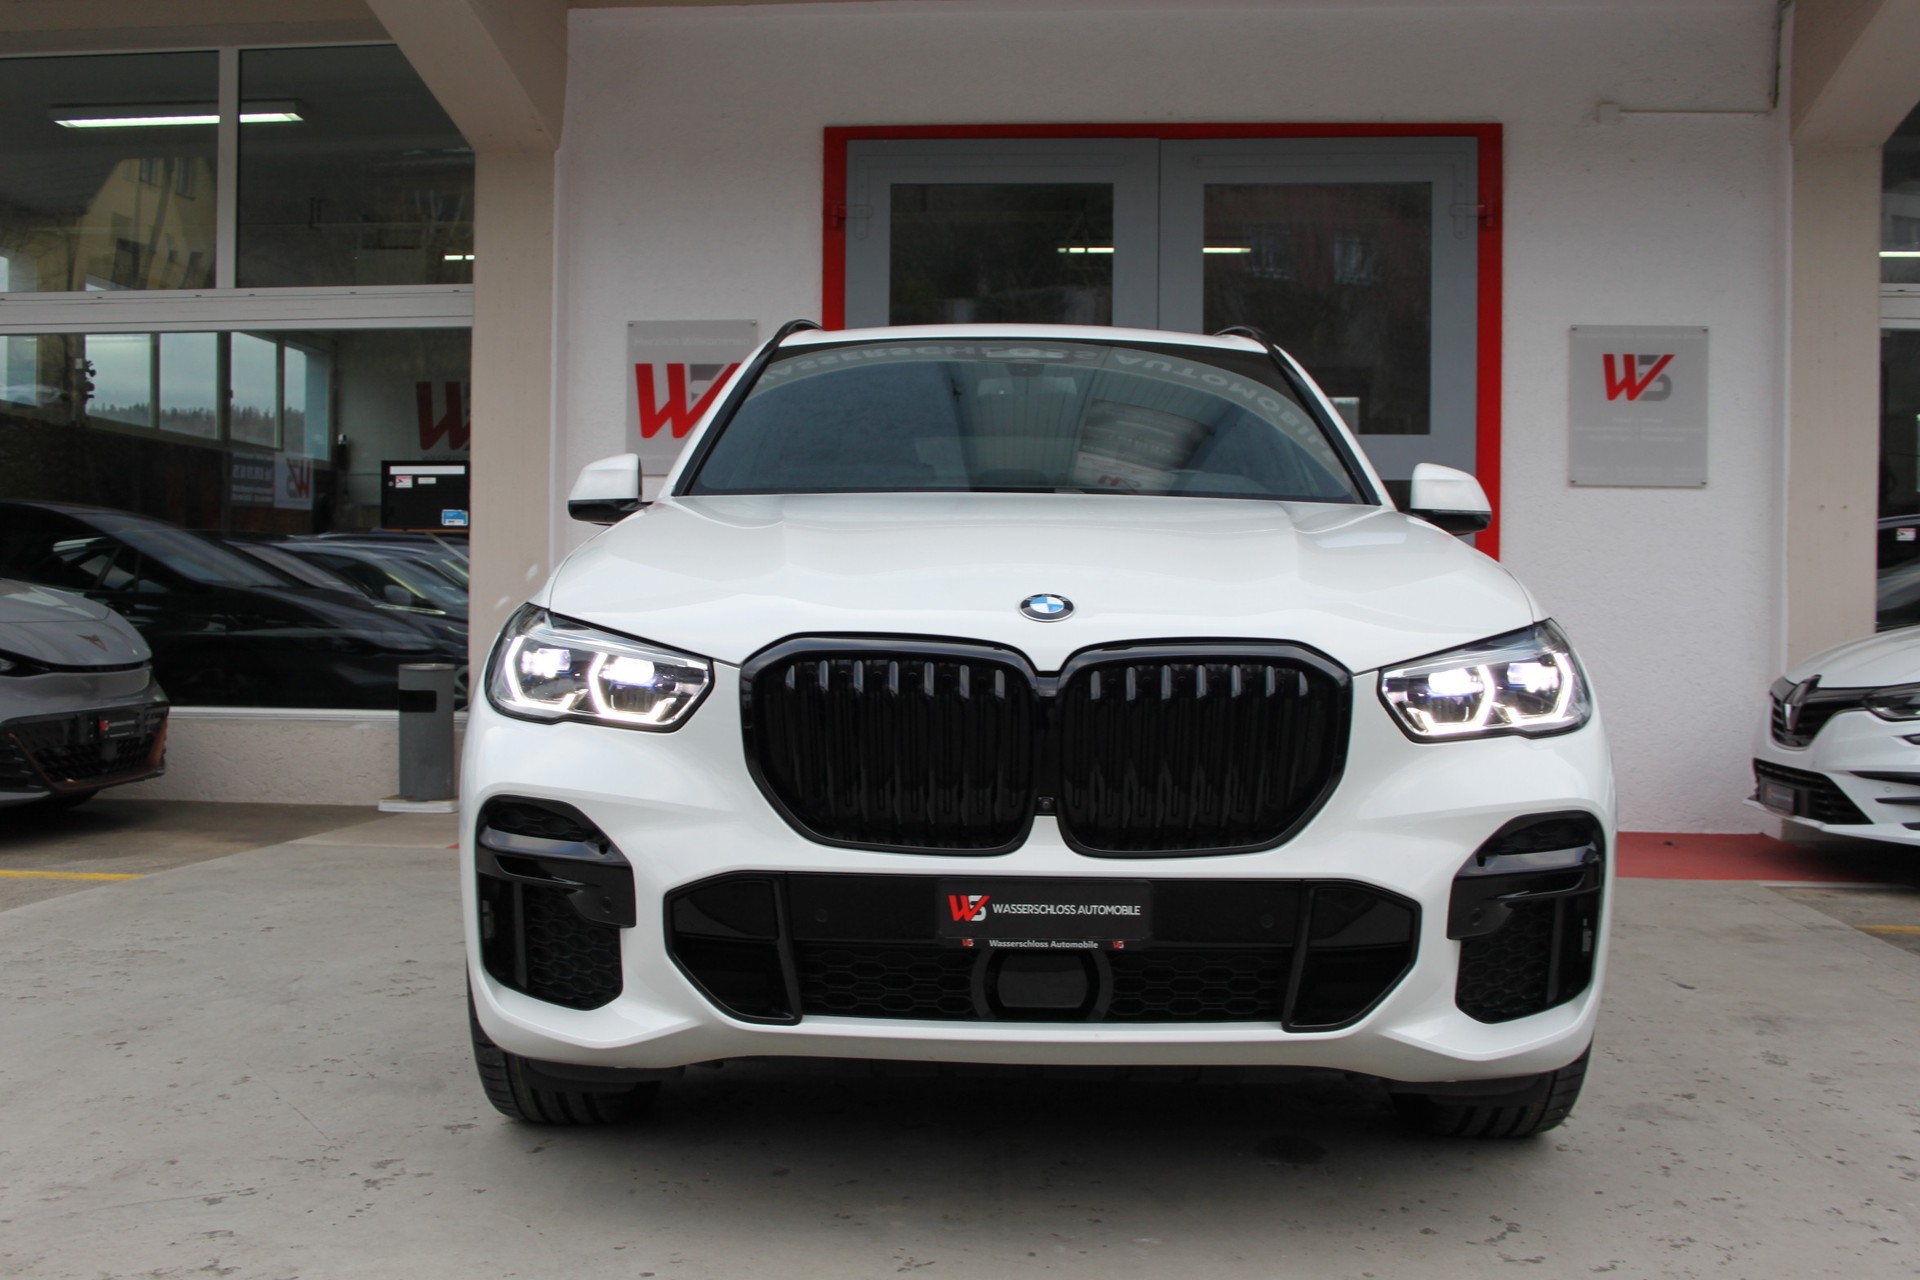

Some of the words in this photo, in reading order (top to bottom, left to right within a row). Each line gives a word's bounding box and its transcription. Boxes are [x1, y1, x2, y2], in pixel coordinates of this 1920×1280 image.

[992, 903, 1076, 915] WASSERSCHLOSS
[1077, 904, 1141, 916] AUTOMOBILE
[989, 939, 1049, 948] Wasserschloss
[1050, 940, 1099, 949] Automobile
